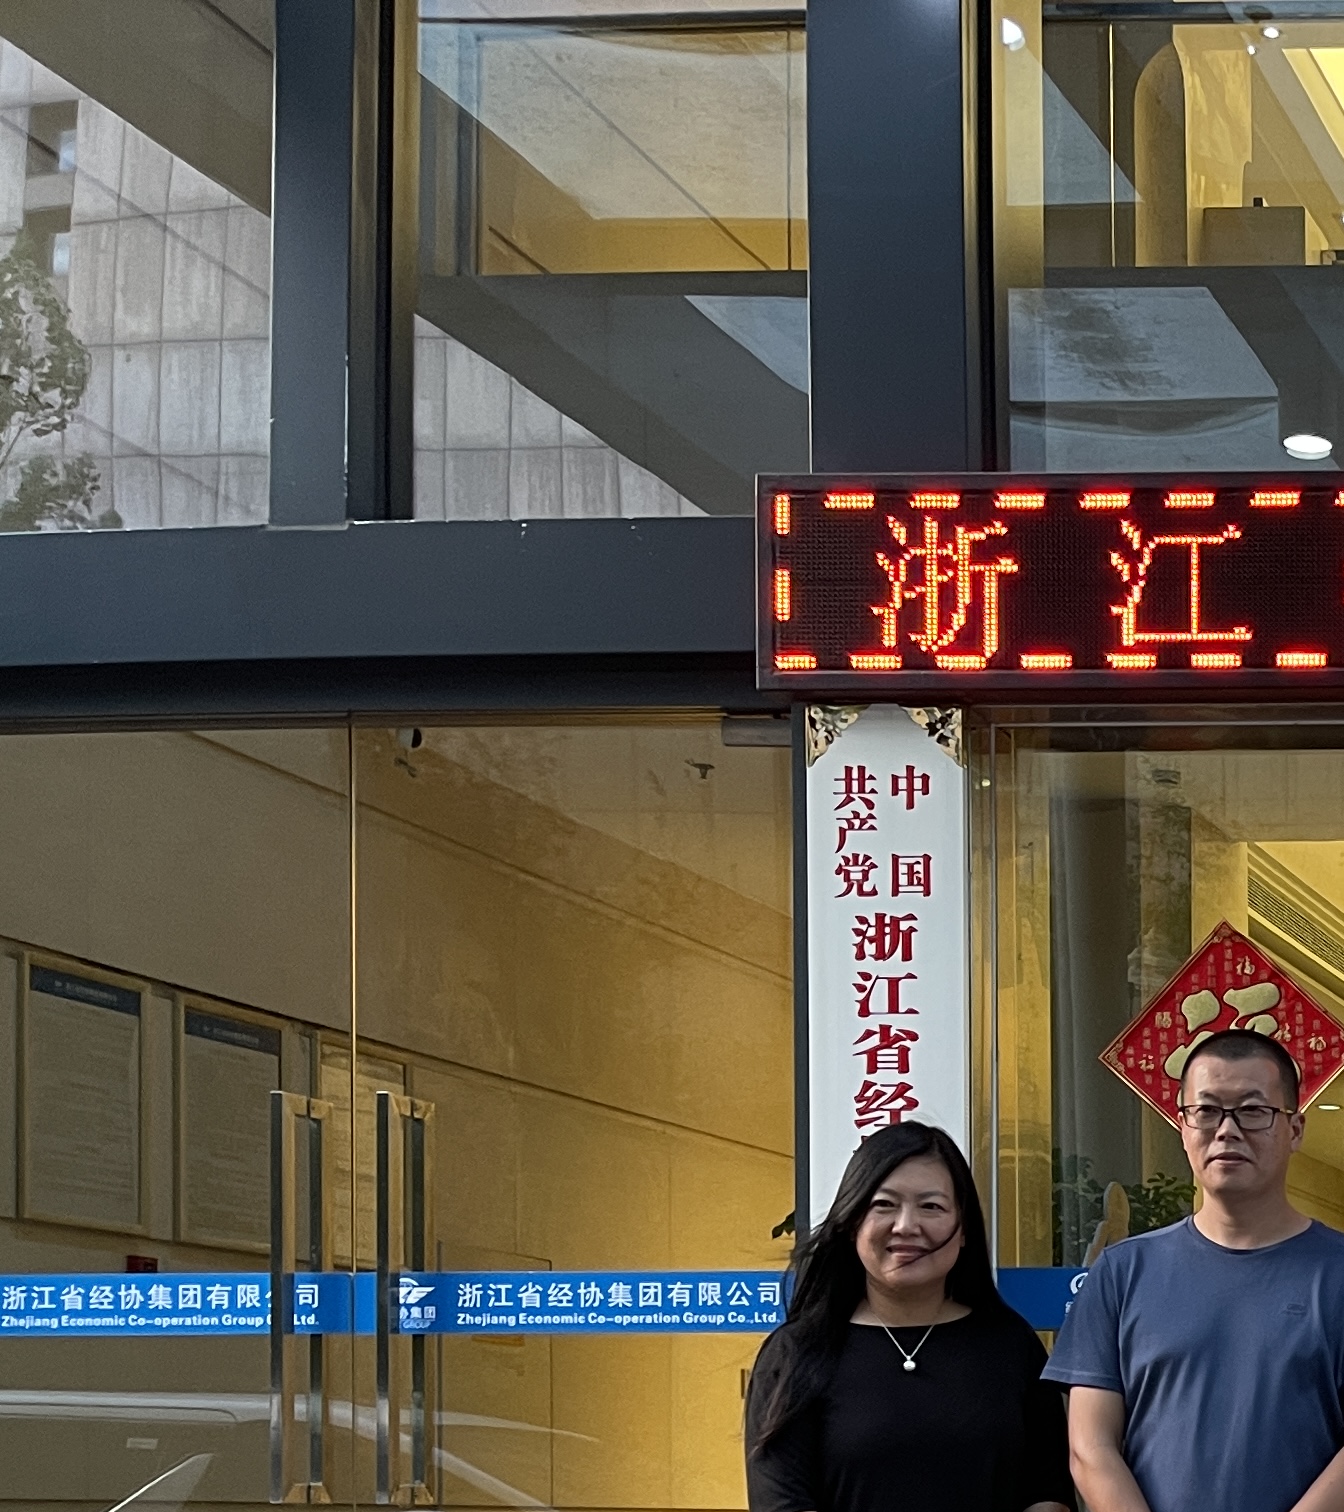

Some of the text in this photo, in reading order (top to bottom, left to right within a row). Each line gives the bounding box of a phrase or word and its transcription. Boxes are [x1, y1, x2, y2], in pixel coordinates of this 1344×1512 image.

[833, 764, 879, 899] 共产党
[851, 912, 920, 1153] 浙江省经
[2, 1284, 319, 1310] 浙江省经协集团有限司
[457, 1281, 780, 1308] 浙江省经协集团有限公司
[1, 1315, 59, 1329] Zhejiang
[61, 1314, 126, 1327] Economic
[128, 1314, 219, 1329] Co-operation
[222, 1314, 264, 1328] Group
[457, 1313, 516, 1327] Zhejiang
[518, 1313, 586, 1325] Economic
[587, 1312, 680, 1326] Co-operation
[682, 1312, 725, 1326] Group
